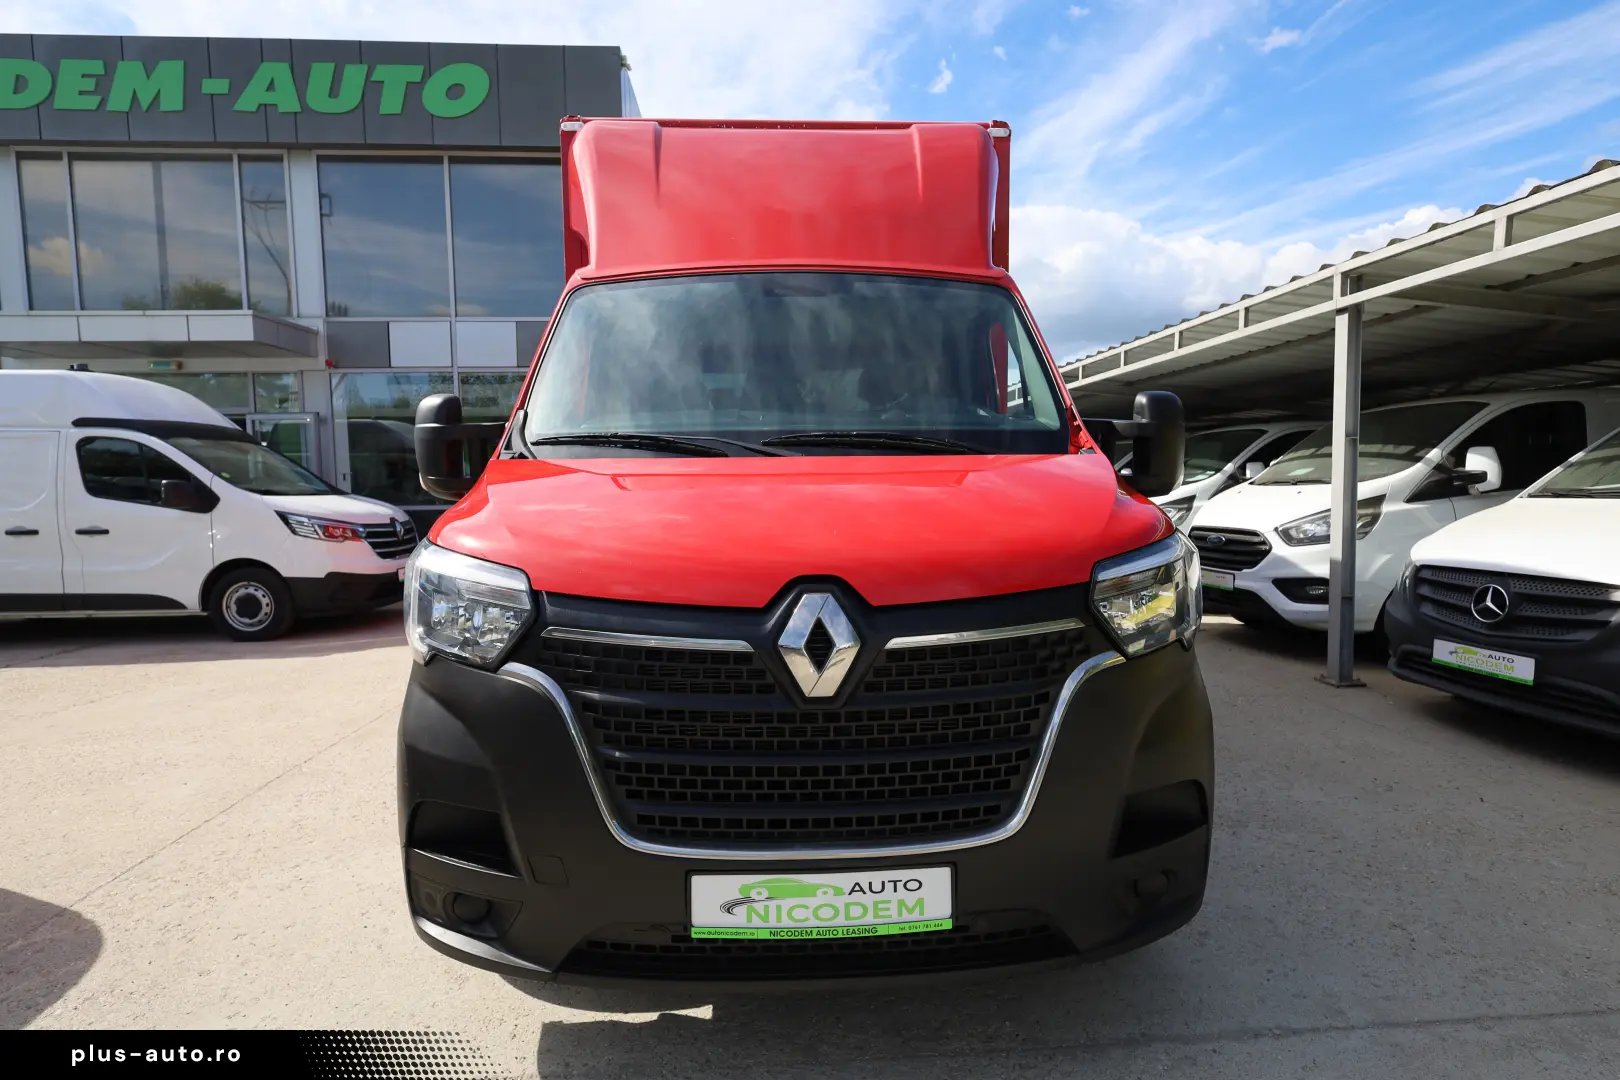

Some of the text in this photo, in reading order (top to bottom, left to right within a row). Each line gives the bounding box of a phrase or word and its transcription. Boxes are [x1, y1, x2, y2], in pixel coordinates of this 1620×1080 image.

[1455, 653, 1516, 673] NICODEM
[1487, 653, 1515, 664] AUTO
[847, 879, 923, 896] AUTO
[746, 897, 925, 924] NICODEM
[769, 926, 878, 937] NICODEM AUTO LEASING
